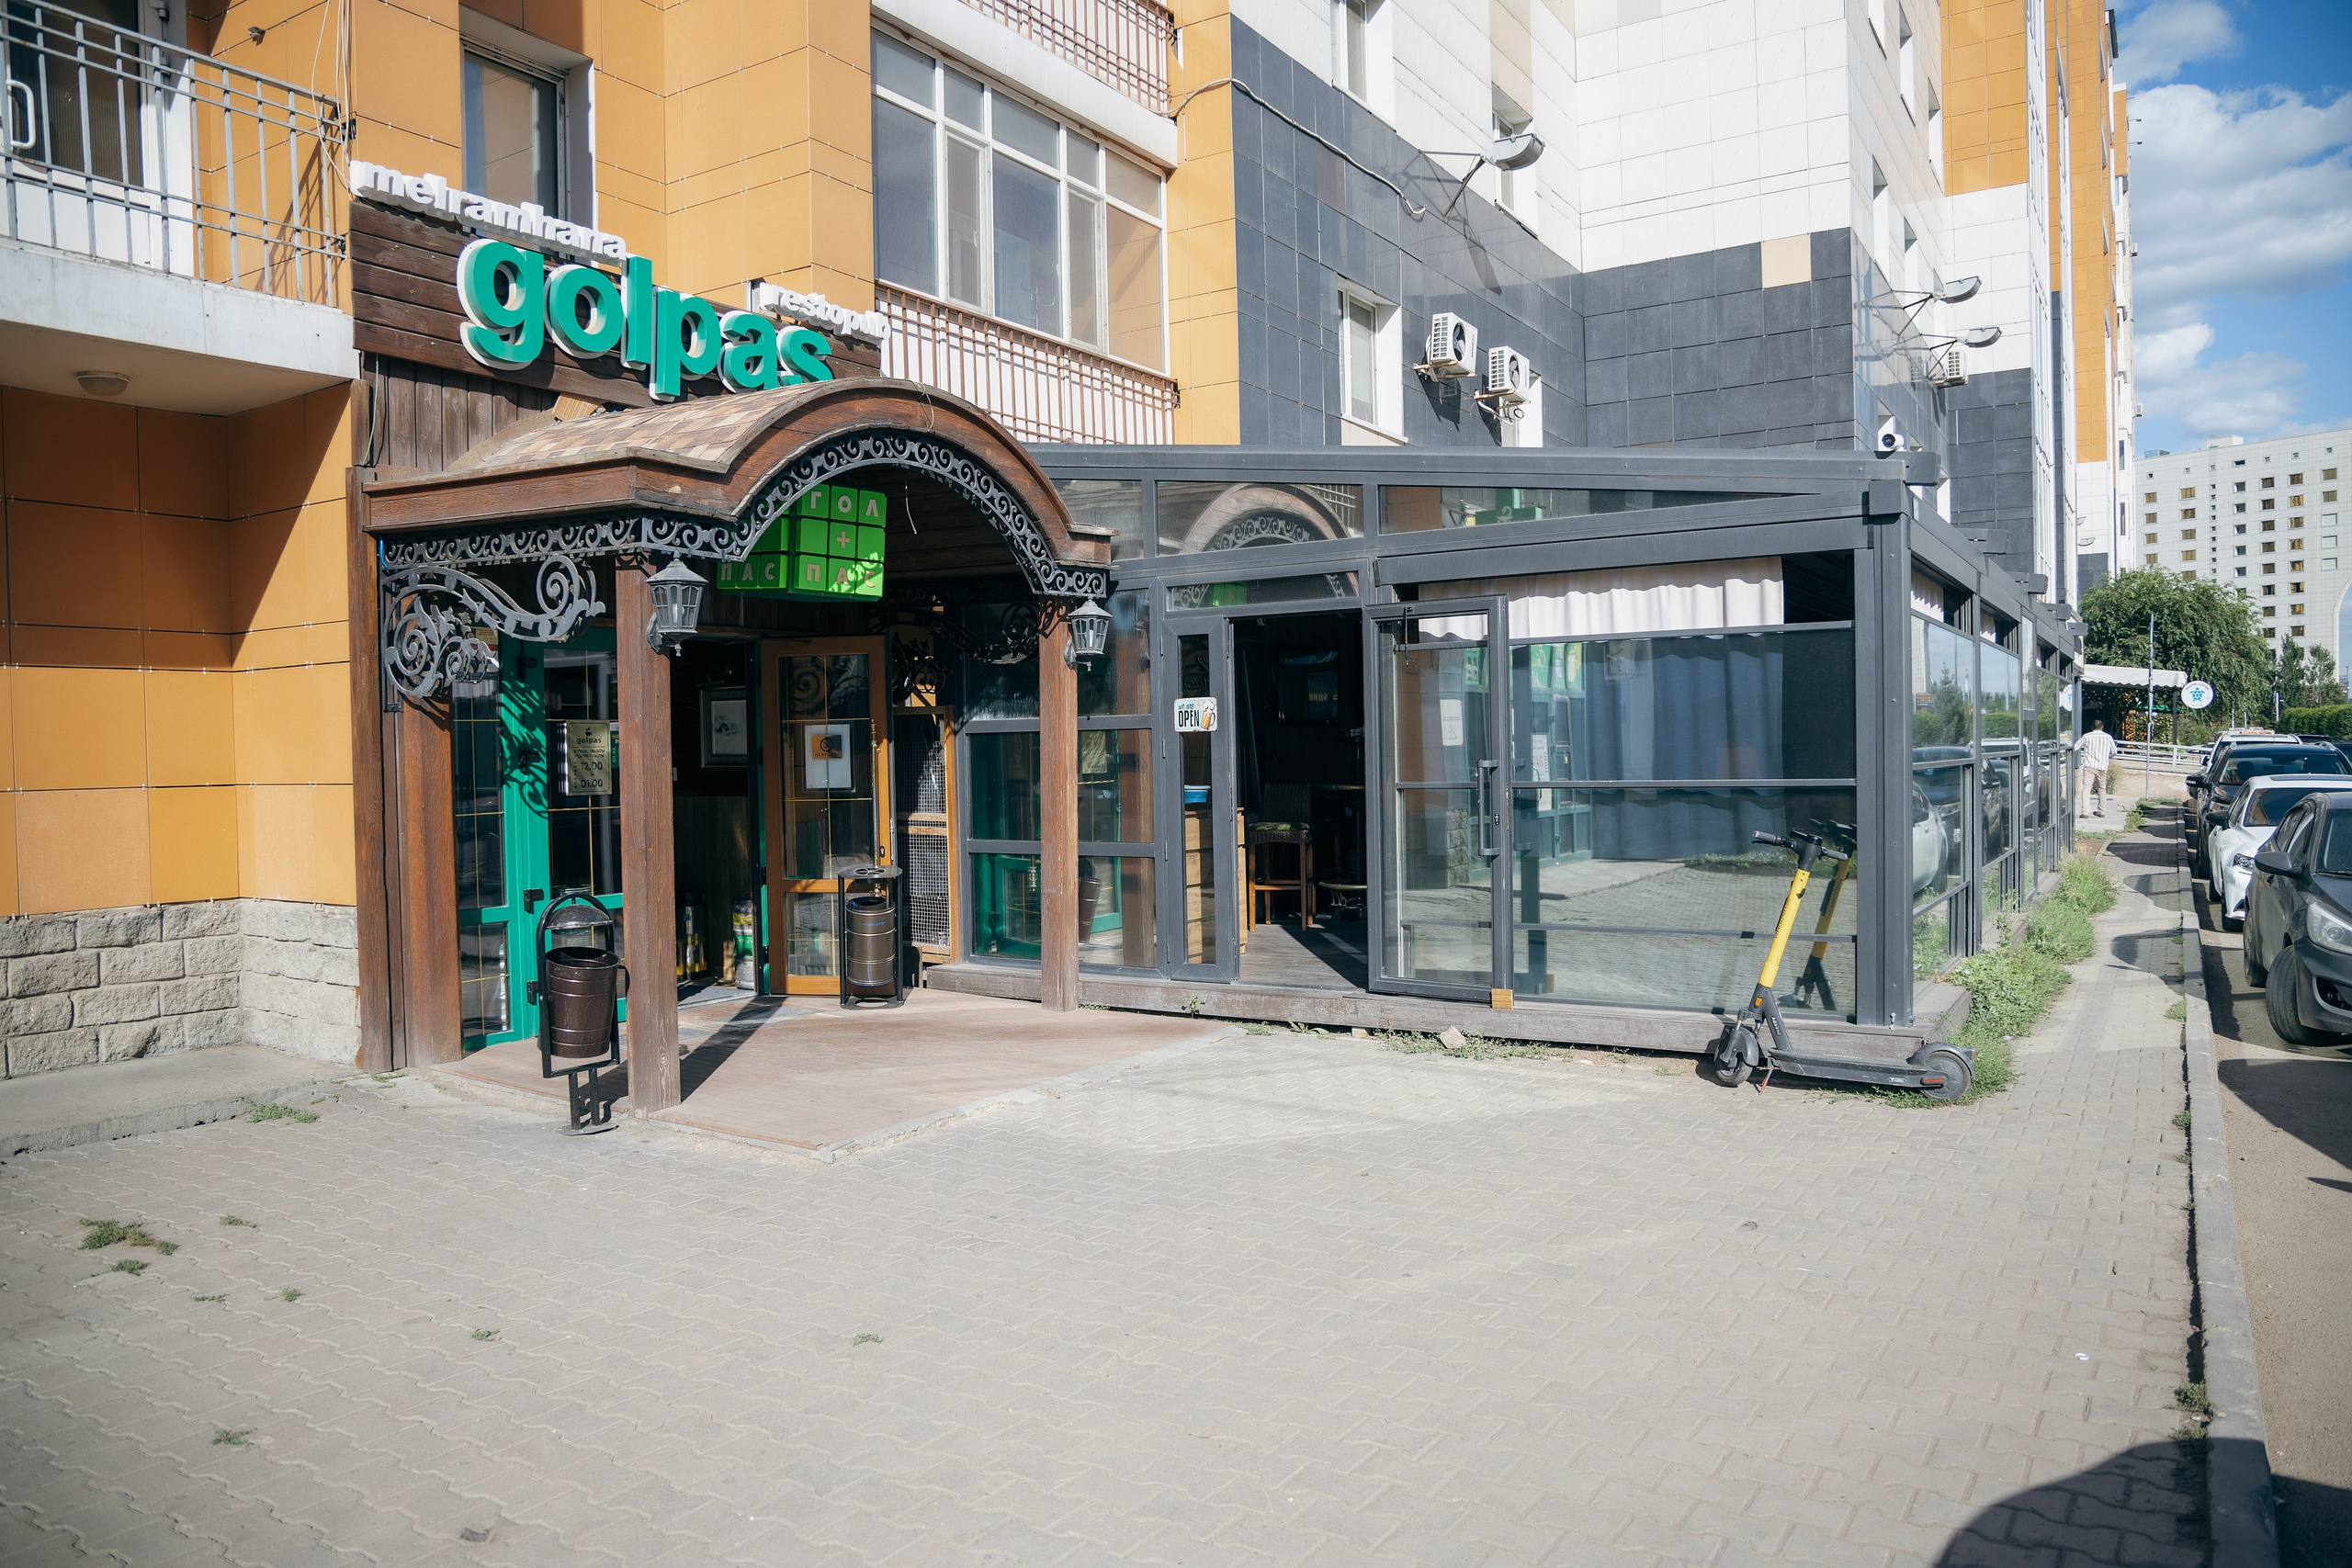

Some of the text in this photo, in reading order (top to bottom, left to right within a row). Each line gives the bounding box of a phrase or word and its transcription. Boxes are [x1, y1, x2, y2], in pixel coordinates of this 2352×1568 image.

[458, 237, 834, 402] golpas
[760, 282, 891, 344] restopub
[1179, 710, 1200, 728] OPEN
